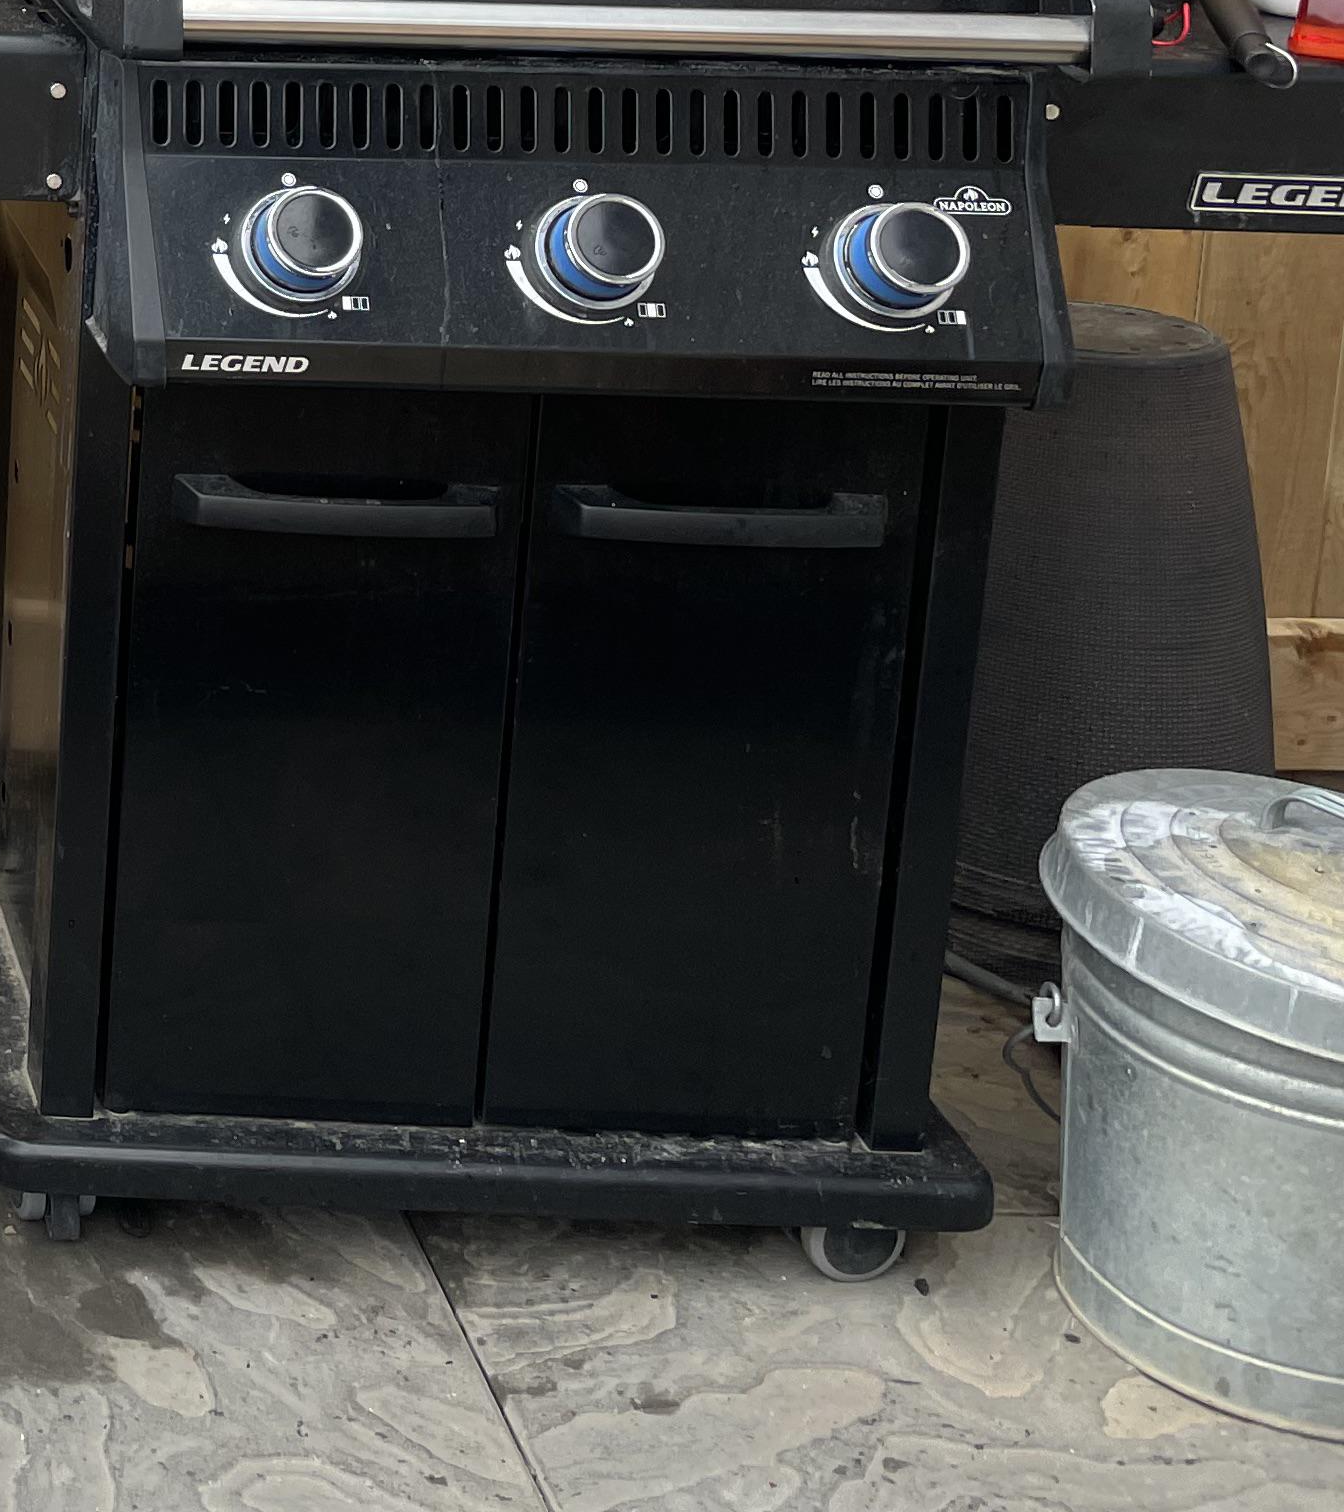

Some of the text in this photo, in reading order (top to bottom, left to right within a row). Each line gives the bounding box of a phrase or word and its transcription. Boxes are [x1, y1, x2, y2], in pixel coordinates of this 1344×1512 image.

[1201, 182, 1344, 208] LEGE
[938, 201, 1006, 212] NAPOLEON
[181, 354, 309, 373] LEGEND
